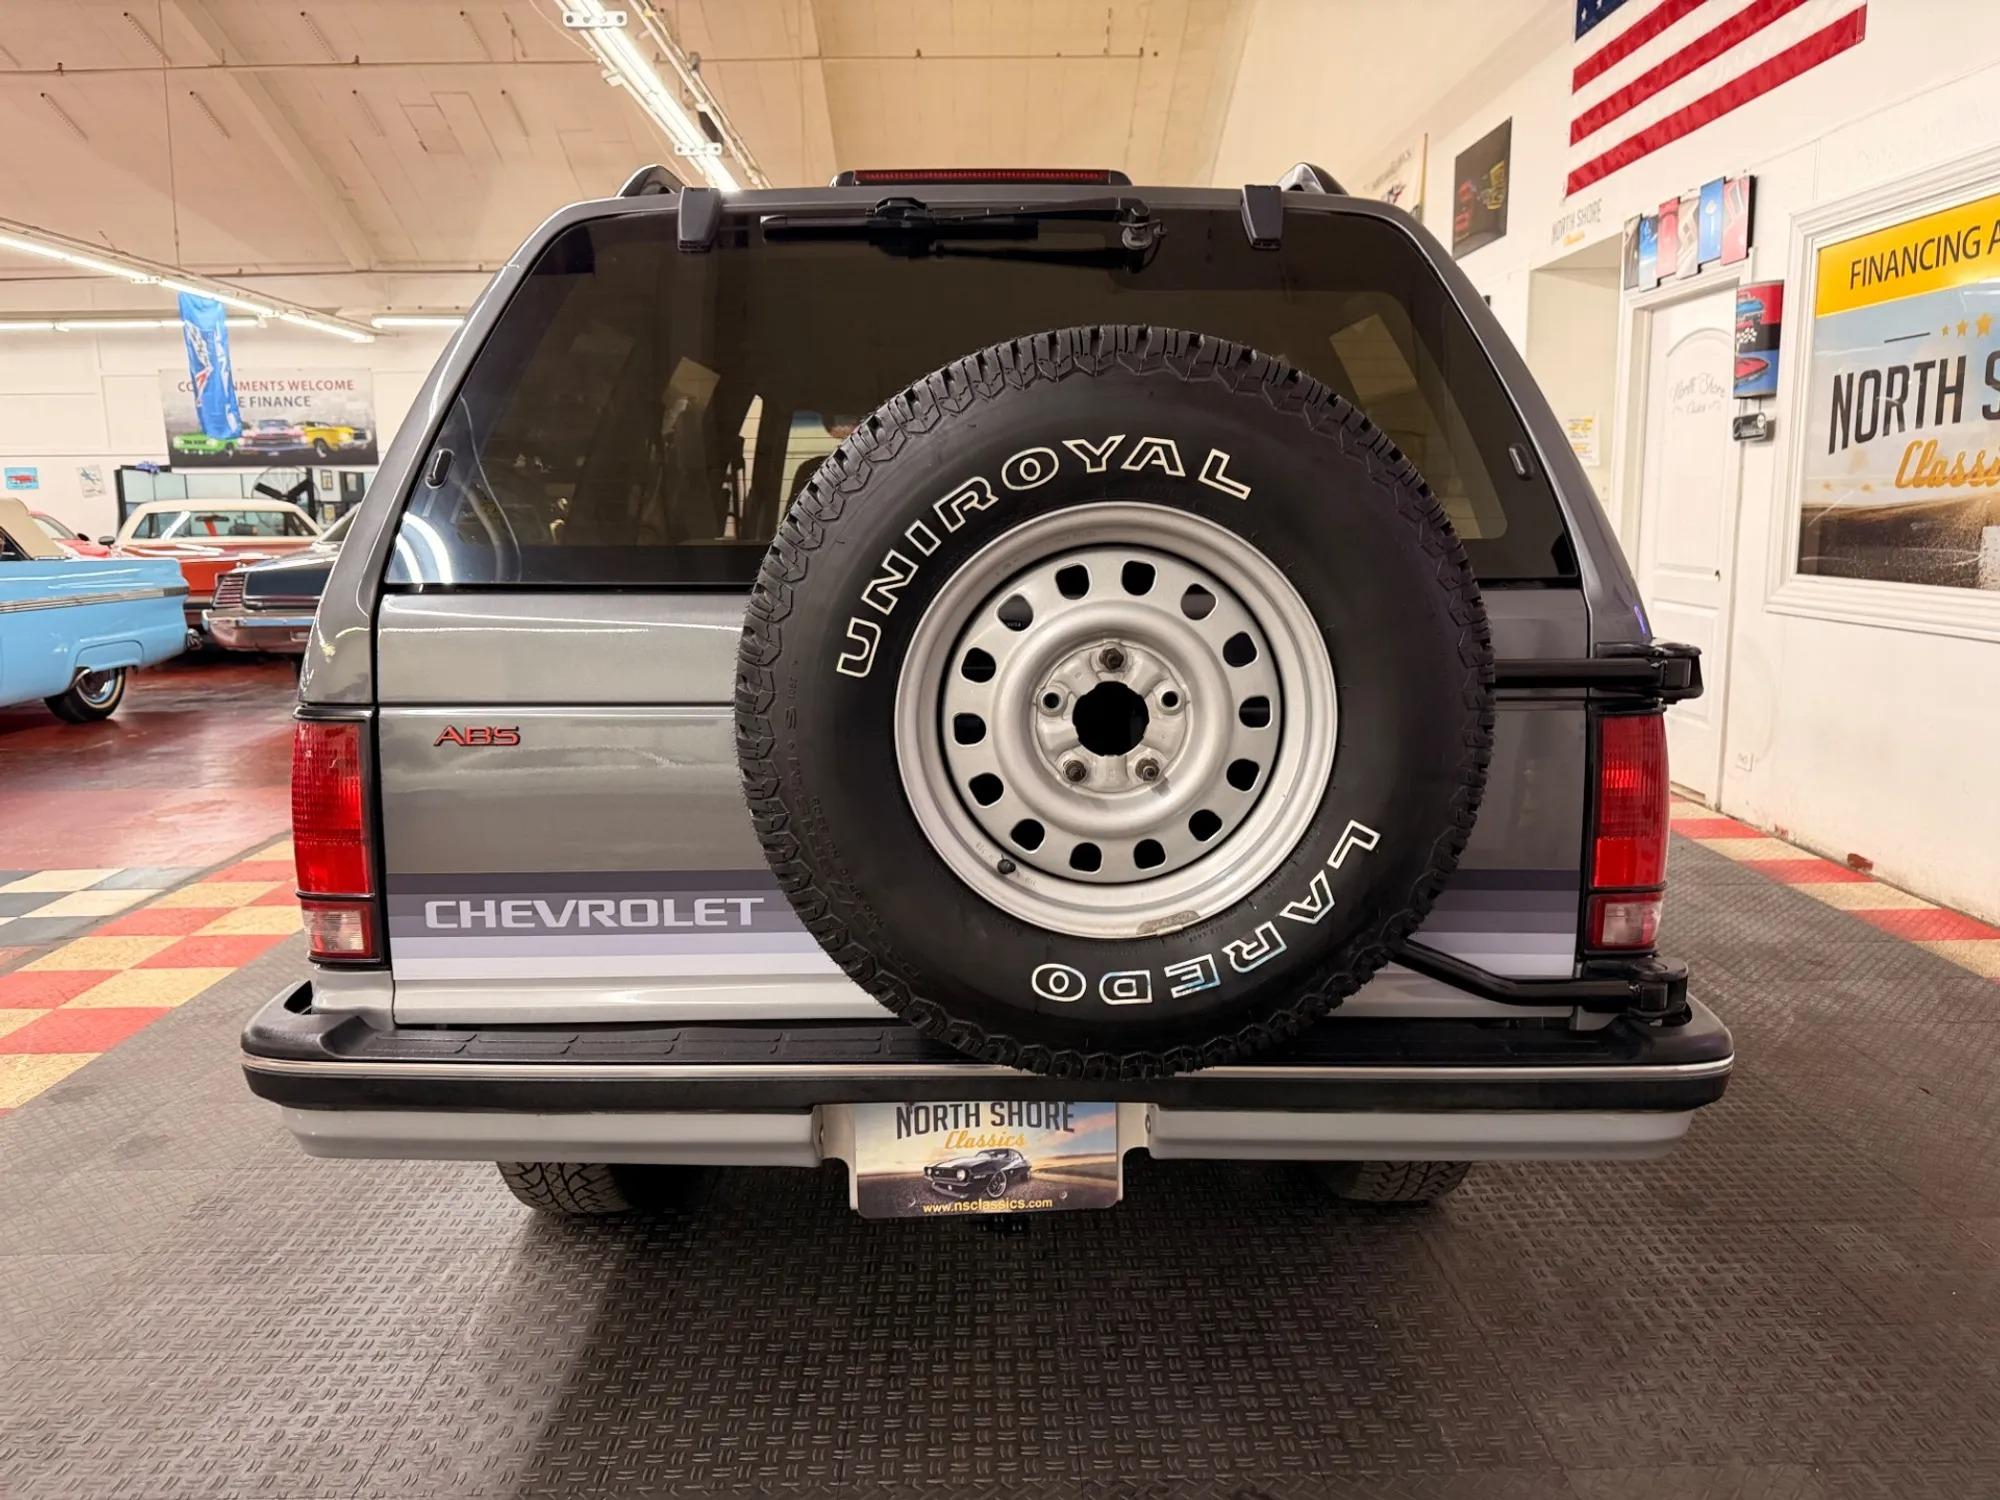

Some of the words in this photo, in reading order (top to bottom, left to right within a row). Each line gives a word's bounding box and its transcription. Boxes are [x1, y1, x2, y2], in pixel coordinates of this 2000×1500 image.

[1850, 225, 1981, 290] FINANCING
[288, 379, 354, 391] WELCOME
[249, 395, 312, 408] FINANCE
[1828, 355, 1967, 456] NORTH
[836, 434, 1252, 678] UNIROYAL
[433, 724, 521, 747] ABS
[424, 897, 765, 929] CHEVROLET
[1031, 819, 1381, 1006] LAREDO
[896, 1103, 981, 1140] NORTH
[990, 1100, 1075, 1133] SHORE
[944, 1130, 1027, 1150] Classics
[923, 1198, 1053, 1213] www.nsclassics.com
